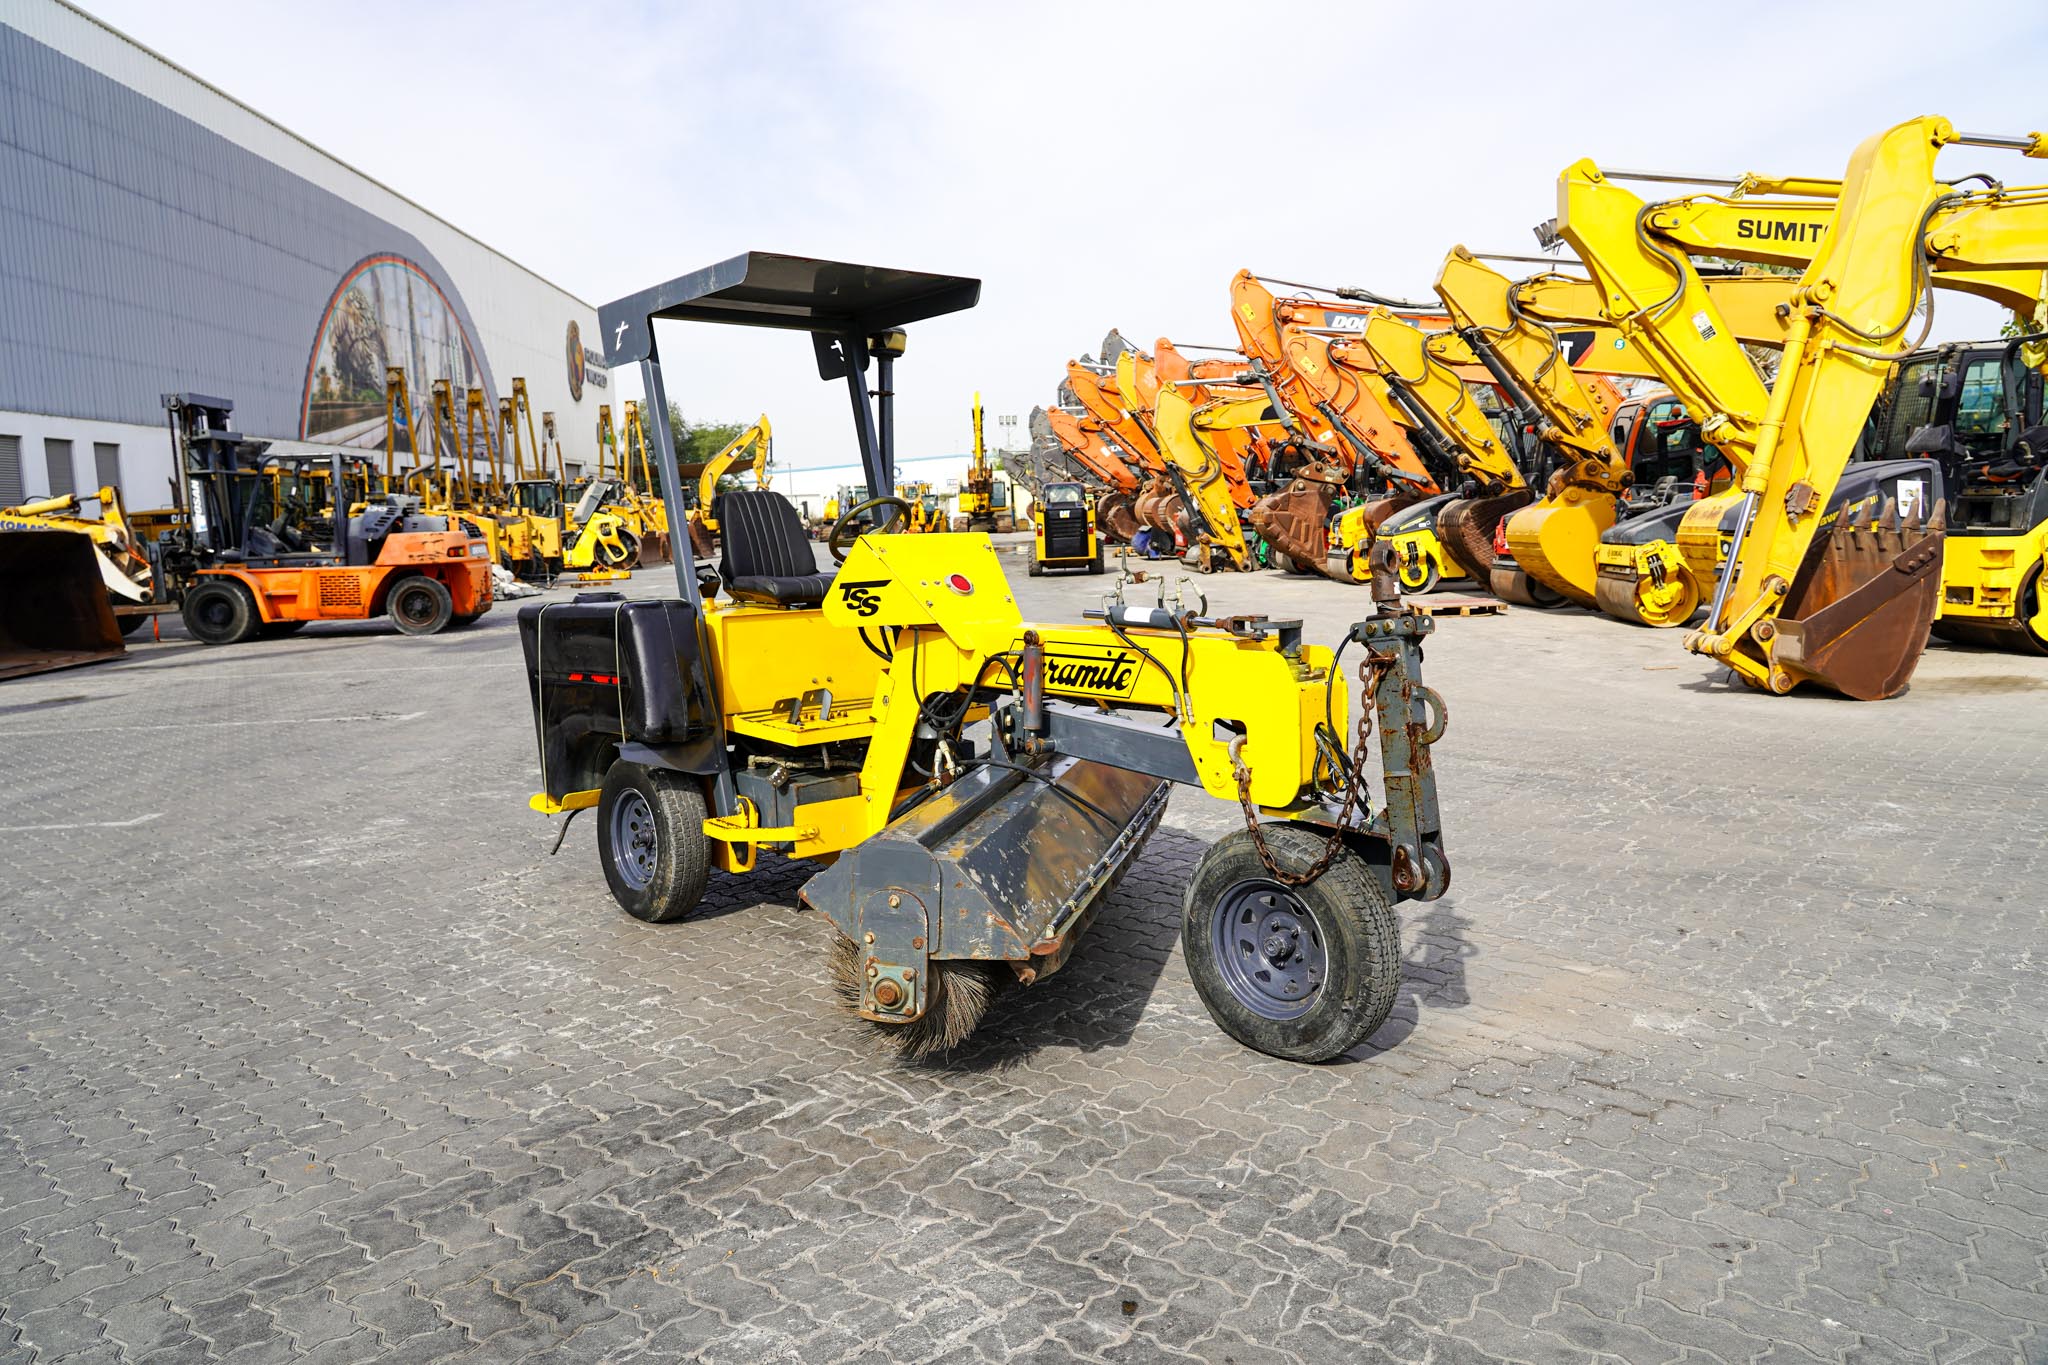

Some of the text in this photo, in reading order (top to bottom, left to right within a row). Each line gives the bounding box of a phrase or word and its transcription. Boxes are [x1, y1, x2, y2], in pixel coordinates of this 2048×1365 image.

[1737, 218, 1829, 243] SUMIT
[839, 579, 893, 617] TSS
[1014, 650, 1137, 691] ramite
